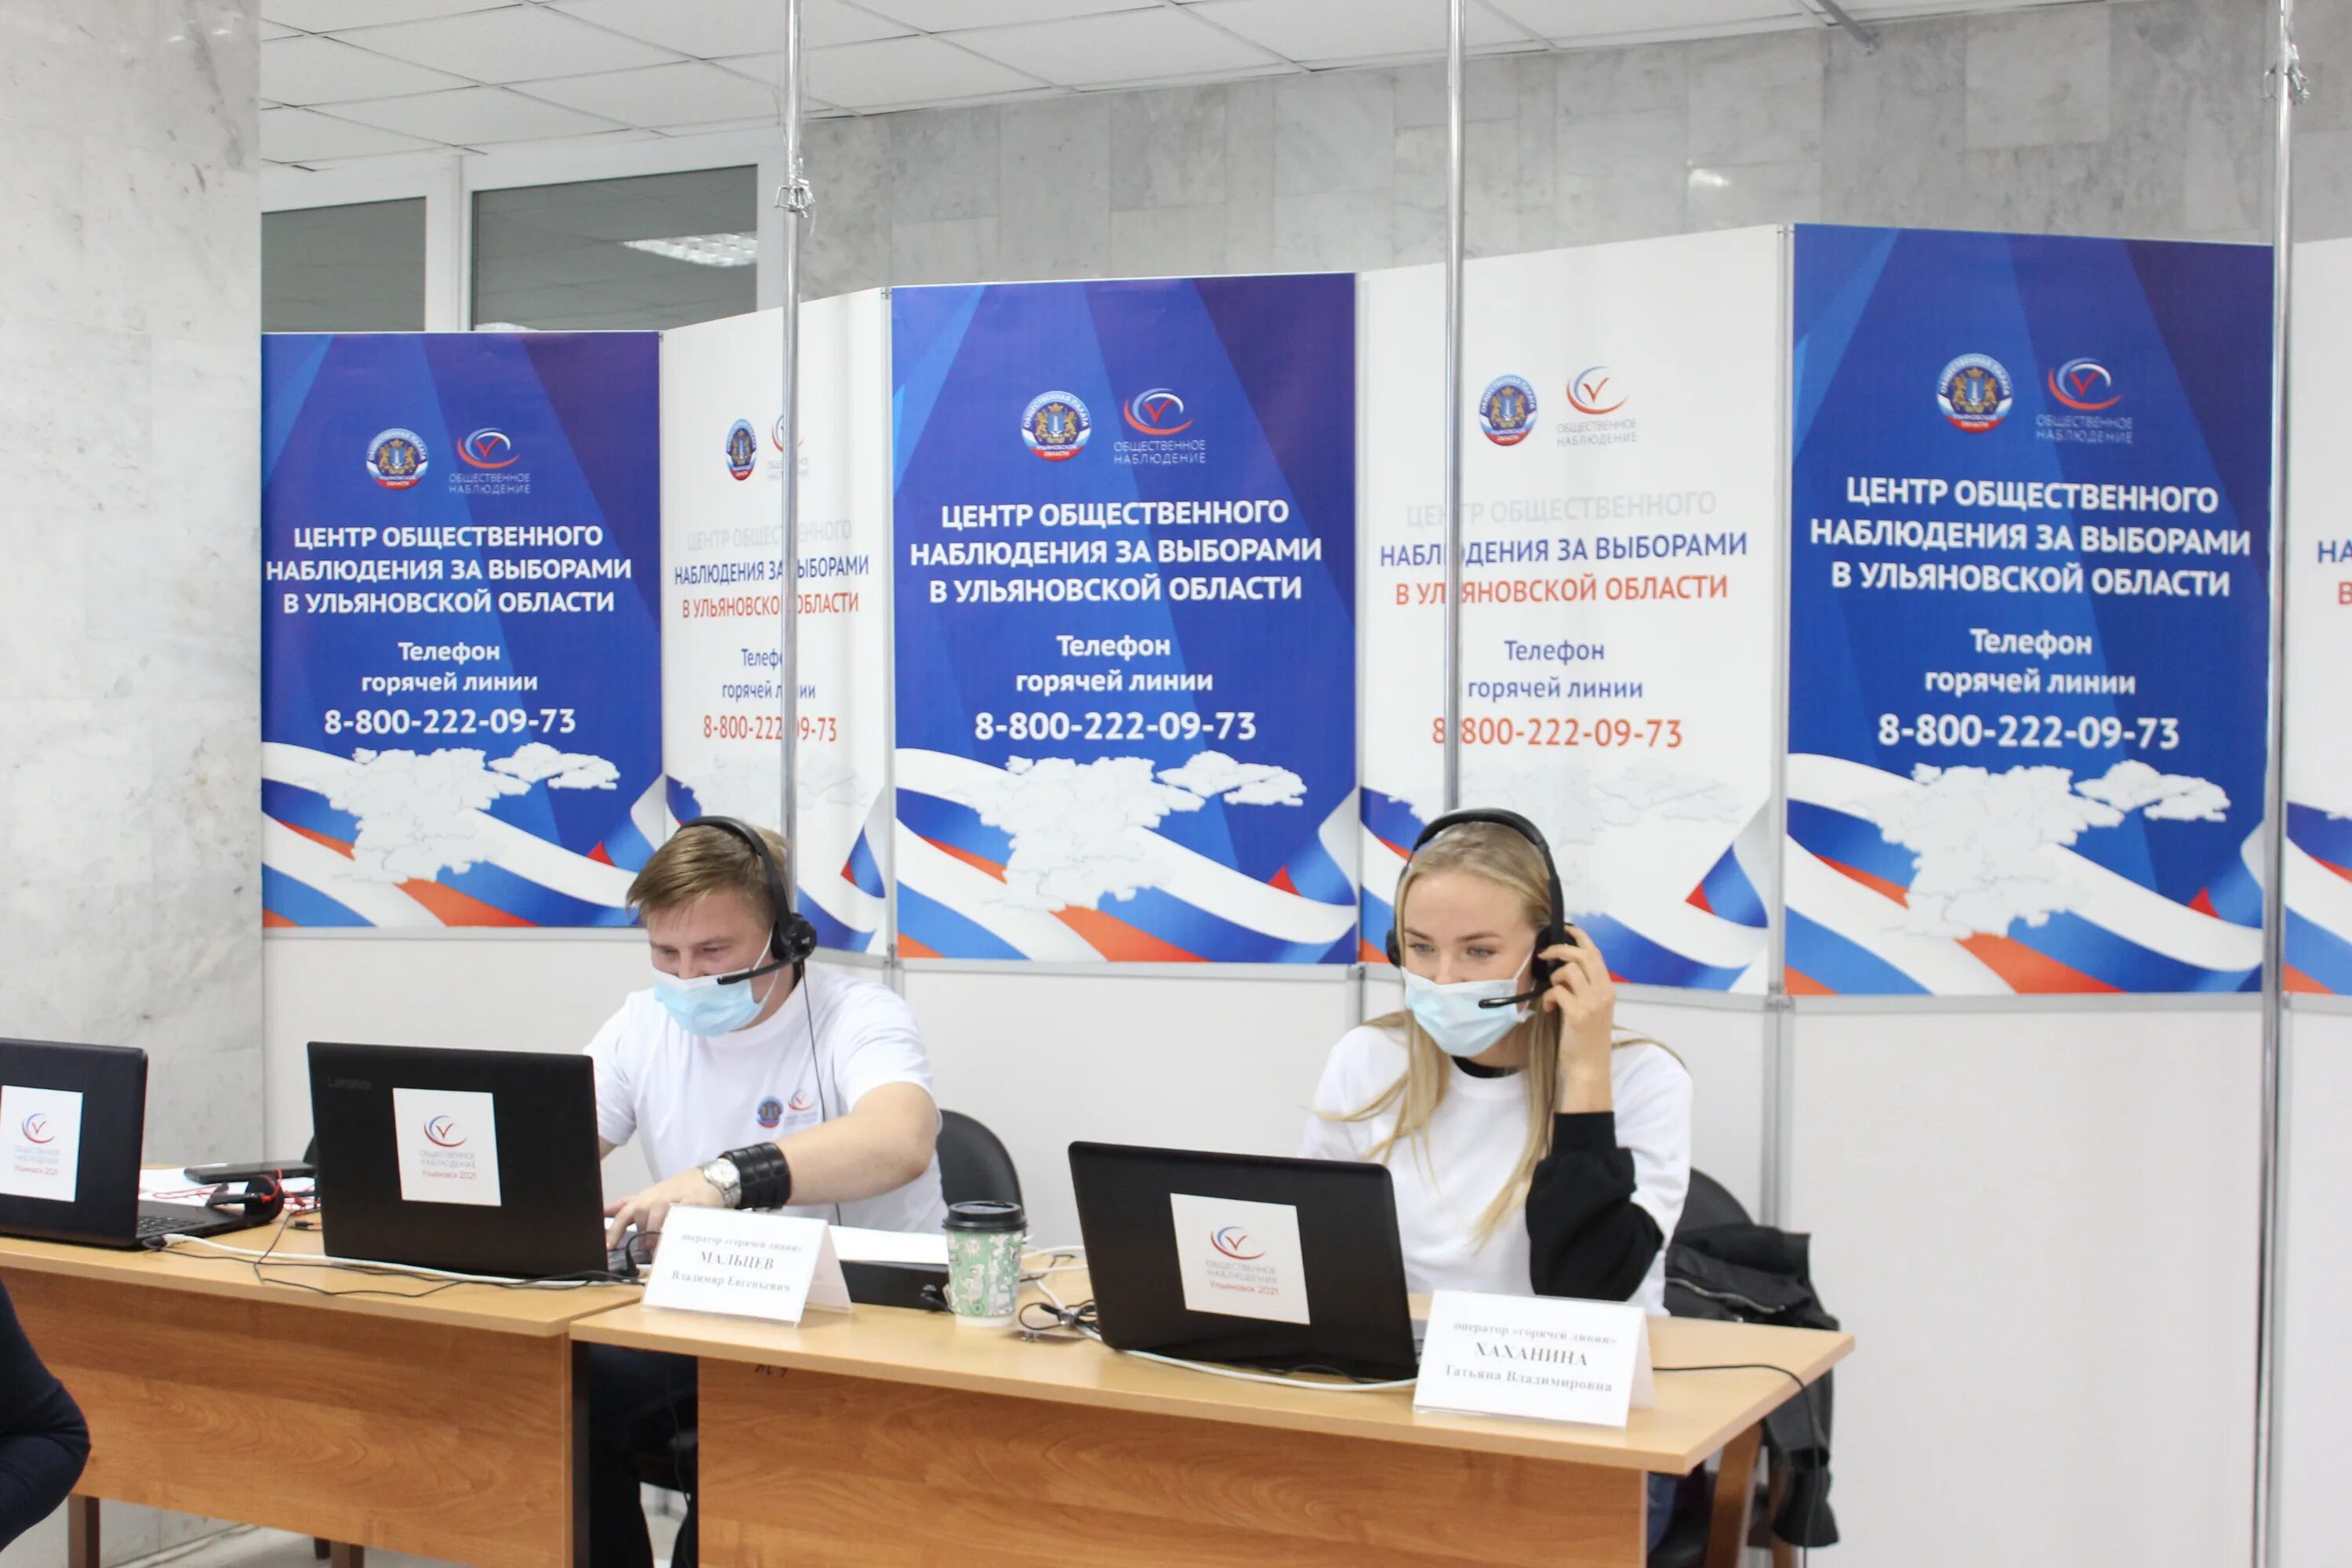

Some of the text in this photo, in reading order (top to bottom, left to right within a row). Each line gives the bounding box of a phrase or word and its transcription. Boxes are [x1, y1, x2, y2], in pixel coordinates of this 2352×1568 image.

[1556, 417, 1637, 434] ОБЩЕСТВЕННОЕ
[2036, 414, 2133, 430] ОБЩЕСТВЕННОЕ
[1113, 439, 1207, 452] ОБЩЕСТВЕННОЕ
[1556, 432, 1638, 447] НАБЛЮДЕНИЕ
[2036, 430, 2133, 445] НАБЛЮДЕНИЕ
[1113, 452, 1207, 465] НАБЛЮДЕНИЕ
[448, 473, 530, 483] ОБЩЕСТВЕННОЕ
[448, 484, 530, 495] НАБЛЮДЕНИЕ
[1490, 490, 1718, 524] ОБЩЕСТВЕННОГО
[1846, 476, 2219, 514] ЦЕНТР ОБЩЕСТВЕННОГО
[942, 499, 1290, 531] ЦЕНТР ОБЩЕСТВЕННОГО
[294, 525, 603, 550] ЦЕНТР ОБЩЕСТВЕННОГО
[734, 519, 851, 550] ОБЩЕСЕННОГО
[1557, 538, 1588, 561] ЗА
[1595, 532, 1748, 561] ВЫБОРАМИ
[1810, 518, 2251, 557] НАБЛЮДЕНИЯ ЗА ВЫБОРАМИ
[910, 537, 1322, 568] НАБЛЮДЕНИЯ ЗА ВЫБОРАМИ
[266, 558, 632, 584] НАБЛЮДЕНИЯ ЗА ВЫБОРАМИ
[674, 554, 869, 586] НАБЛЮДЕНИЯ ЗА ЫБОРАМИ
[1831, 561, 2230, 597] В УЛЬЯНОВСКОЙ ОБЛАСТИ
[283, 588, 615, 614] В УЛЬЯНОВСКОЙ ОБЛАСТИ
[929, 573, 1301, 603] В УЛЬЯНОВСКОЙ ОБЛАСТИ
[1396, 573, 1728, 605] В УЛЯНОВСКОЙ ОБЛАСТИ
[682, 600, 690, 619] В
[693, 596, 781, 619] УЛЬЯНОВСКО
[398, 642, 500, 665] Телефон
[1056, 634, 1171, 661] Телефон
[1504, 640, 1605, 666] Телефон
[1969, 627, 2092, 659] Телефон
[742, 648, 783, 670] Телеф
[361, 672, 538, 695] горячей линии
[722, 680, 815, 702] горячей лии
[1016, 670, 1214, 696] горячей линии
[1468, 676, 1643, 703] горячей линии
[1925, 666, 2136, 697] горячей линии
[324, 708, 576, 735] 8-800-222-09-73
[703, 714, 837, 742] 8-800-2229-73
[975, 711, 1257, 741] 8-800-222-09-73
[1432, 717, 1682, 749] 8800-222-09-73
[1878, 713, 2180, 750] 8-800-222-09-73
[681, 1233, 722, 1247] оператор
[699, 1250, 775, 1270] МАЛЬЦЕВ
[671, 1269, 791, 1292] Владимир Евгеньевич
[1454, 1321, 1509, 1336] оператор
[1475, 1341, 1588, 1367] ХАХАНИНА
[1444, 1363, 1613, 1392] Татьяна Владимировна
